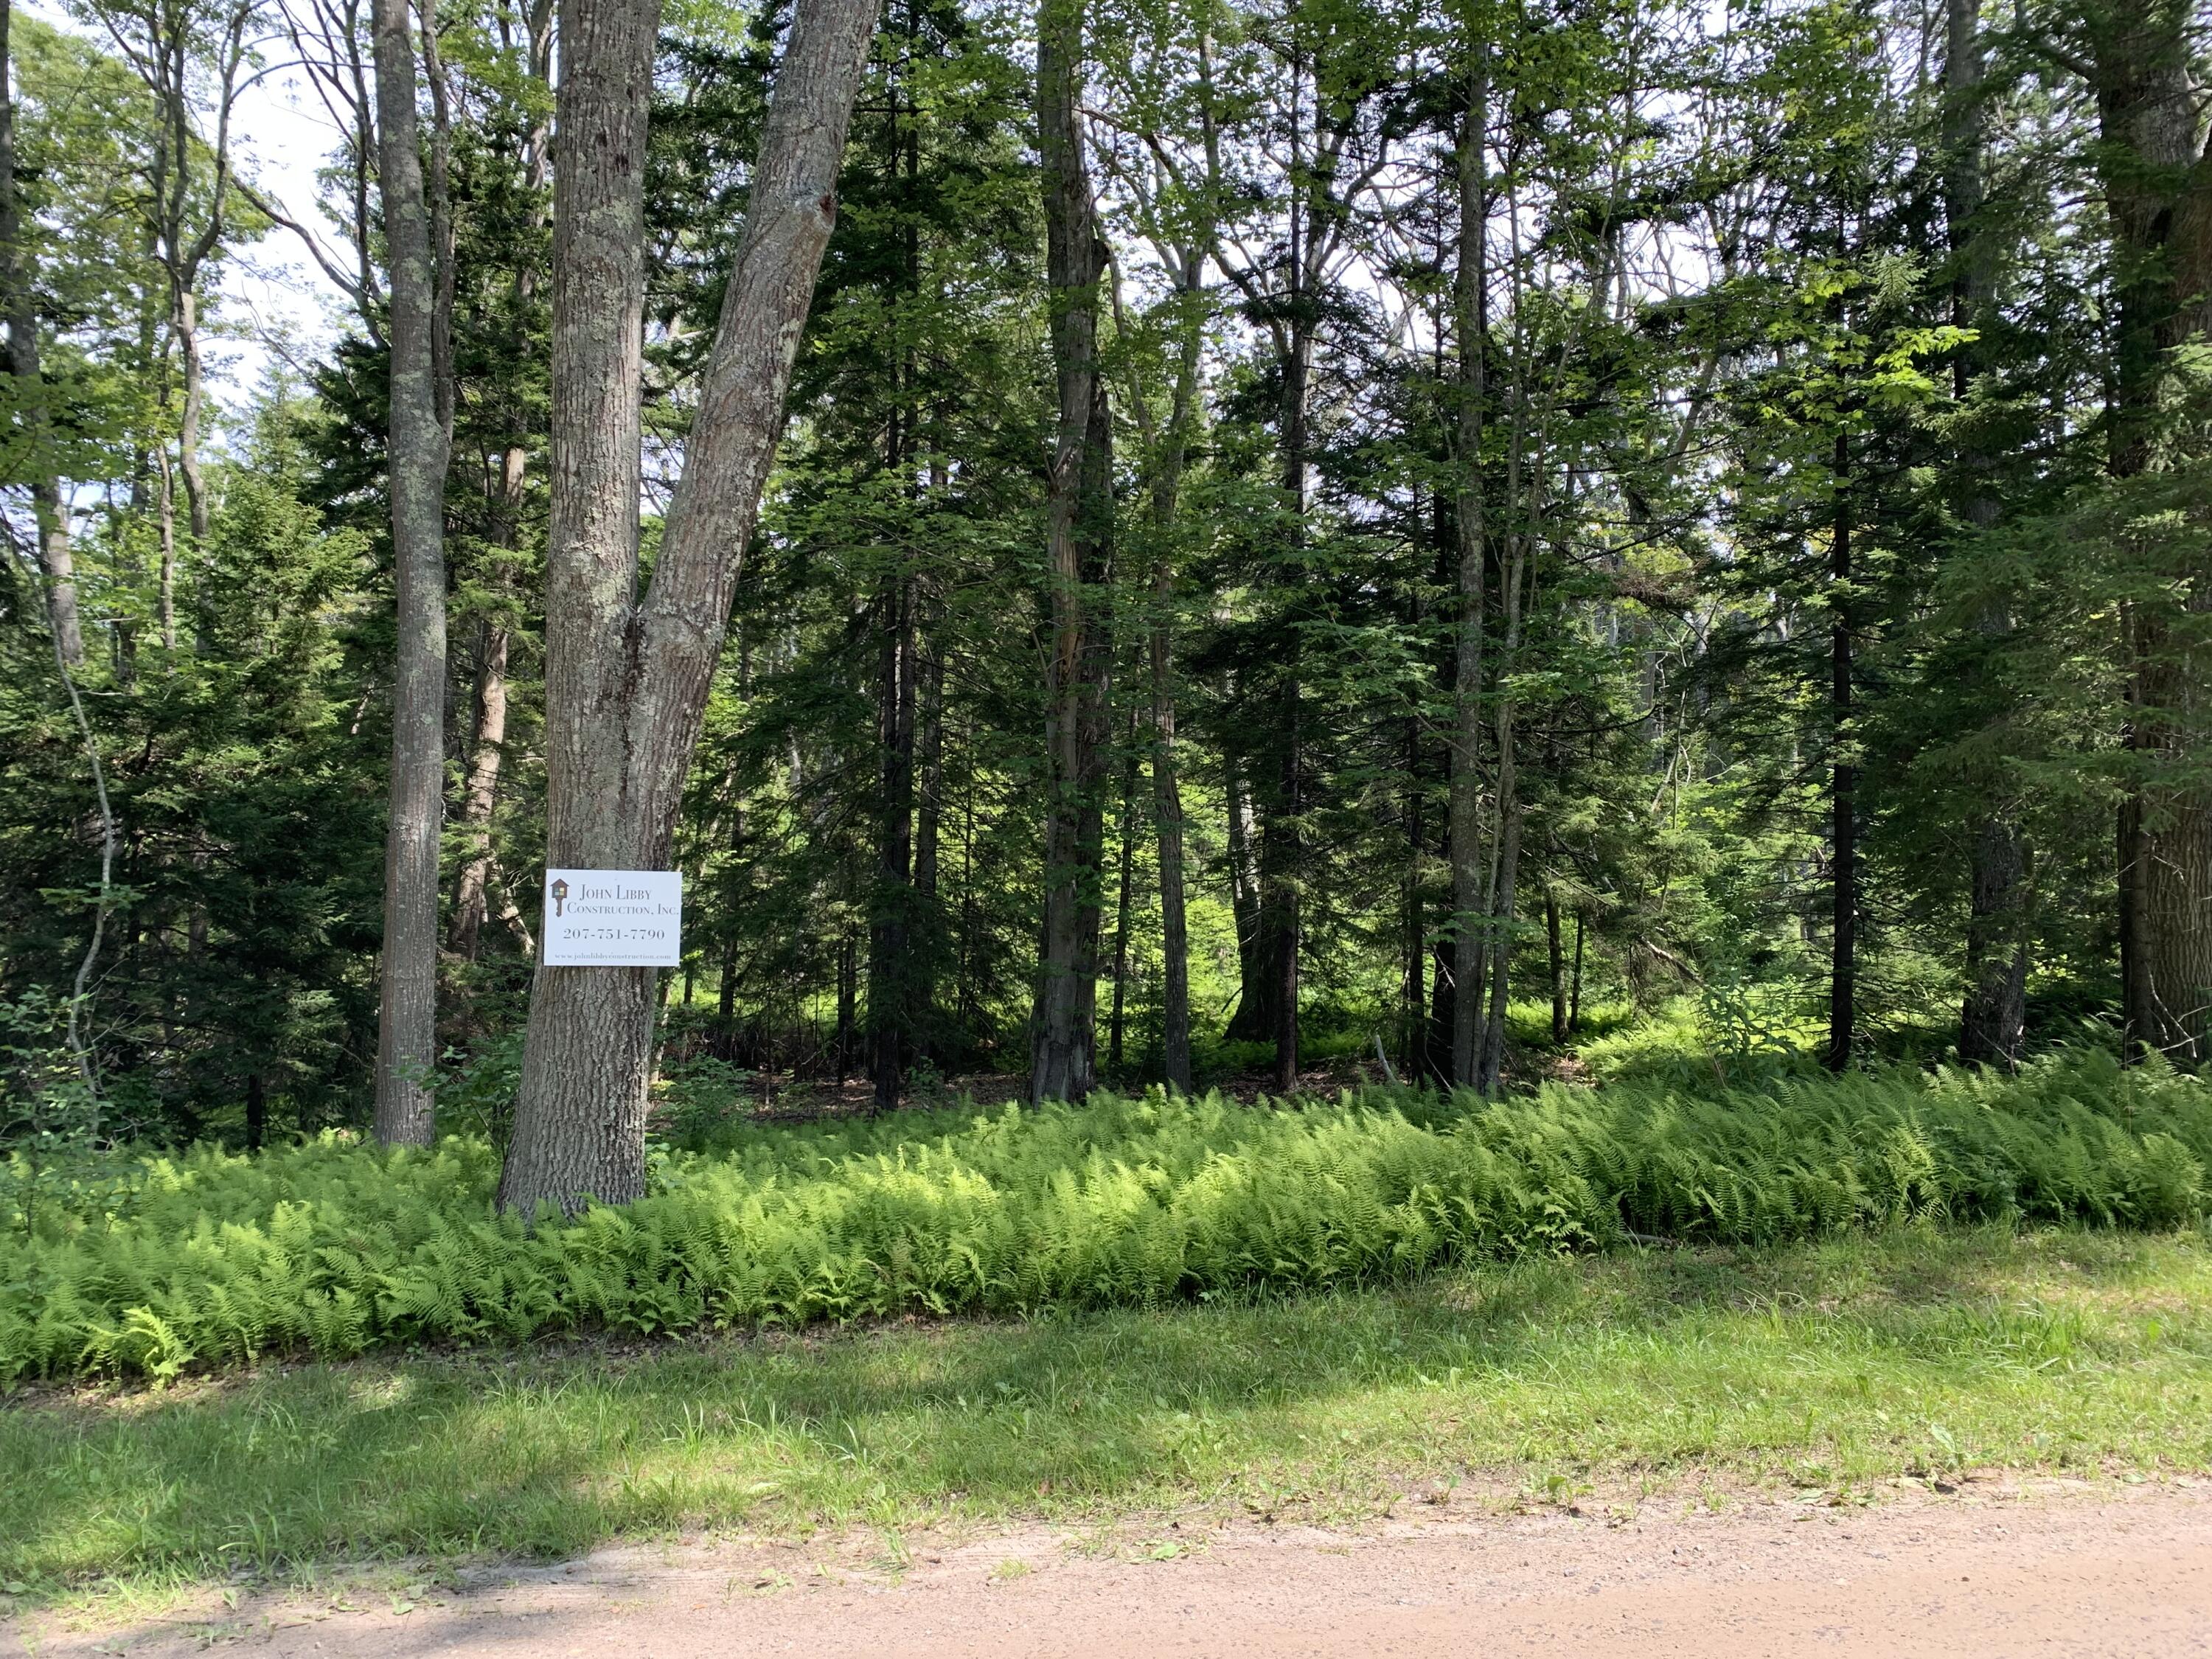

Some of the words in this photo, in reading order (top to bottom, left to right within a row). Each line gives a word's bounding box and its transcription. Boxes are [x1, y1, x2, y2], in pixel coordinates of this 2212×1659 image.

[580, 884, 612, 901] JOHN
[617, 885, 653, 900] LIBBY
[658, 903, 679, 915] INC.
[563, 928, 665, 940] 207-751-7790
[554, 952, 672, 961] www.johnlibbyconstruction.com
